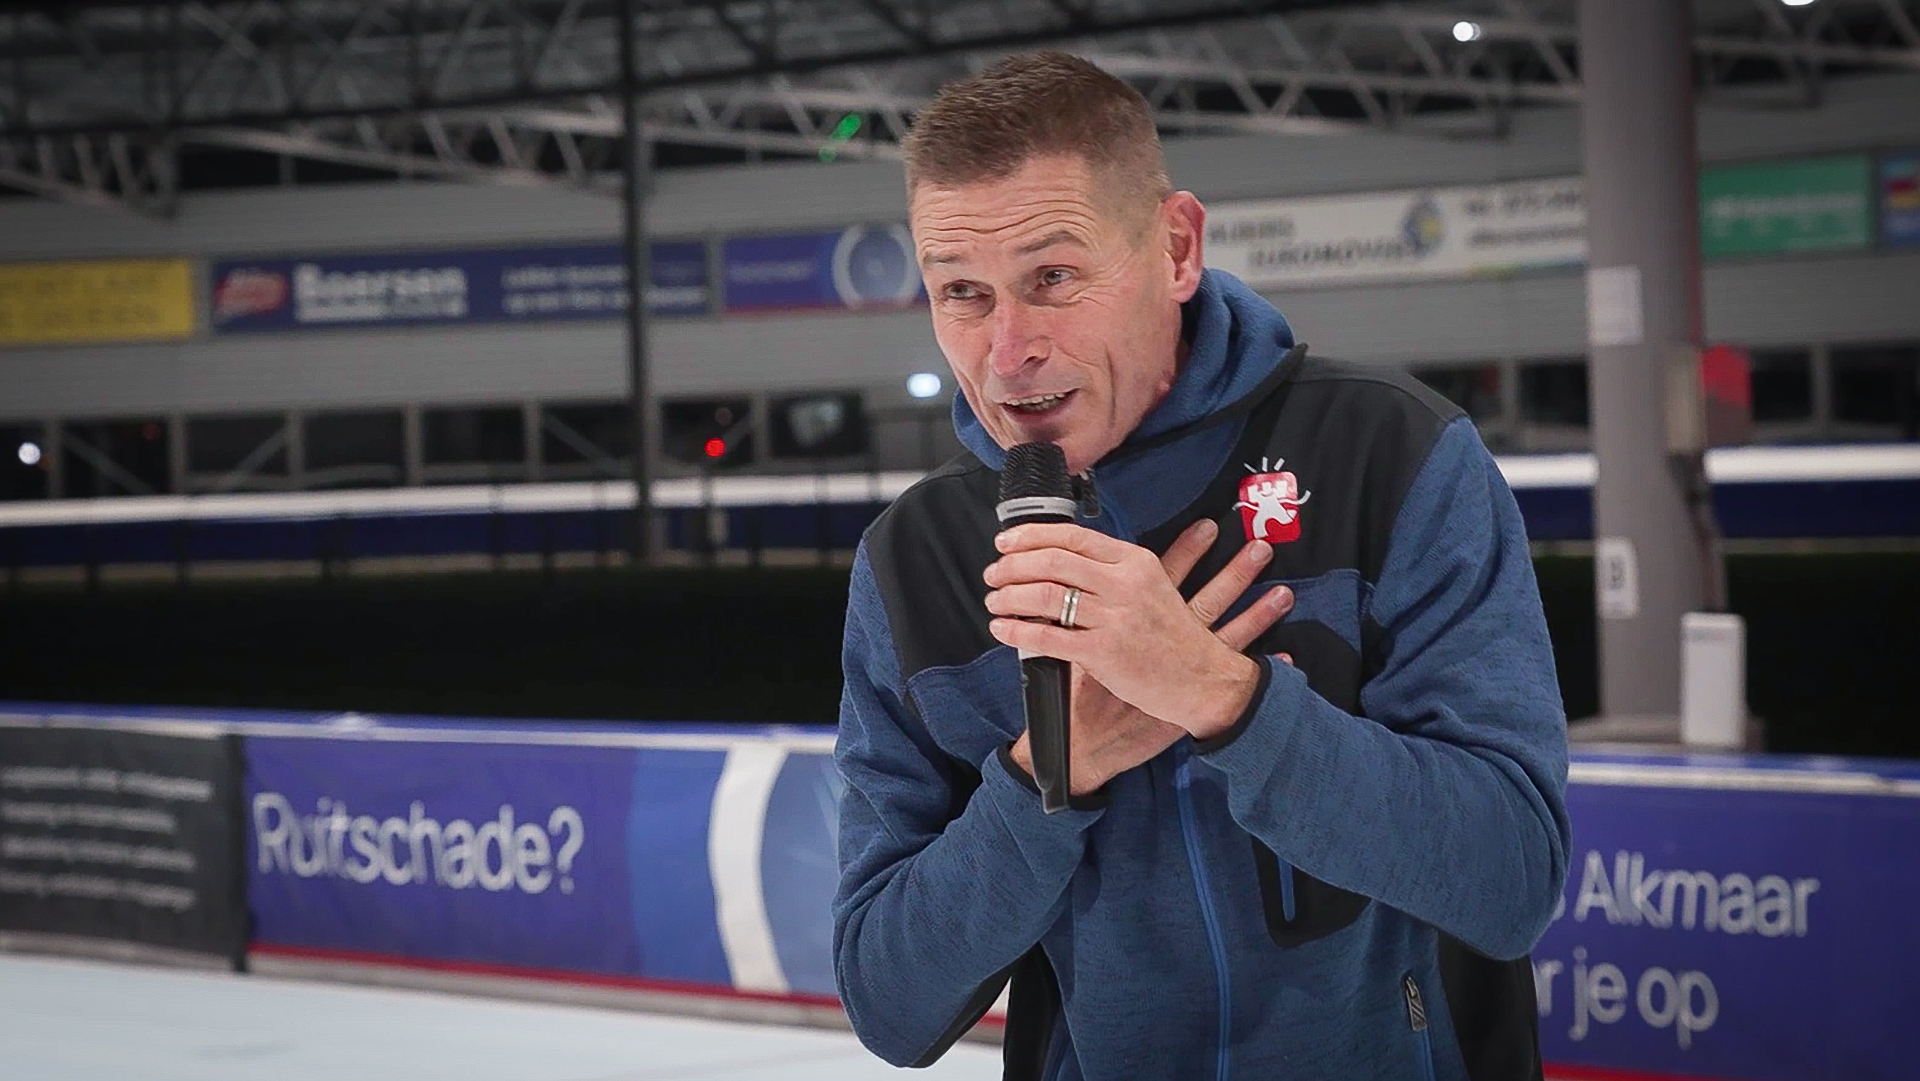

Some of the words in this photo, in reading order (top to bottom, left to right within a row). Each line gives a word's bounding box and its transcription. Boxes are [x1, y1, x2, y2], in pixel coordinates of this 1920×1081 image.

[253, 792, 584, 895] Ruitschade?
[1574, 850, 1820, 937] Alkmaar
[1569, 946, 1628, 1041] je
[1635, 966, 1720, 1051] op
